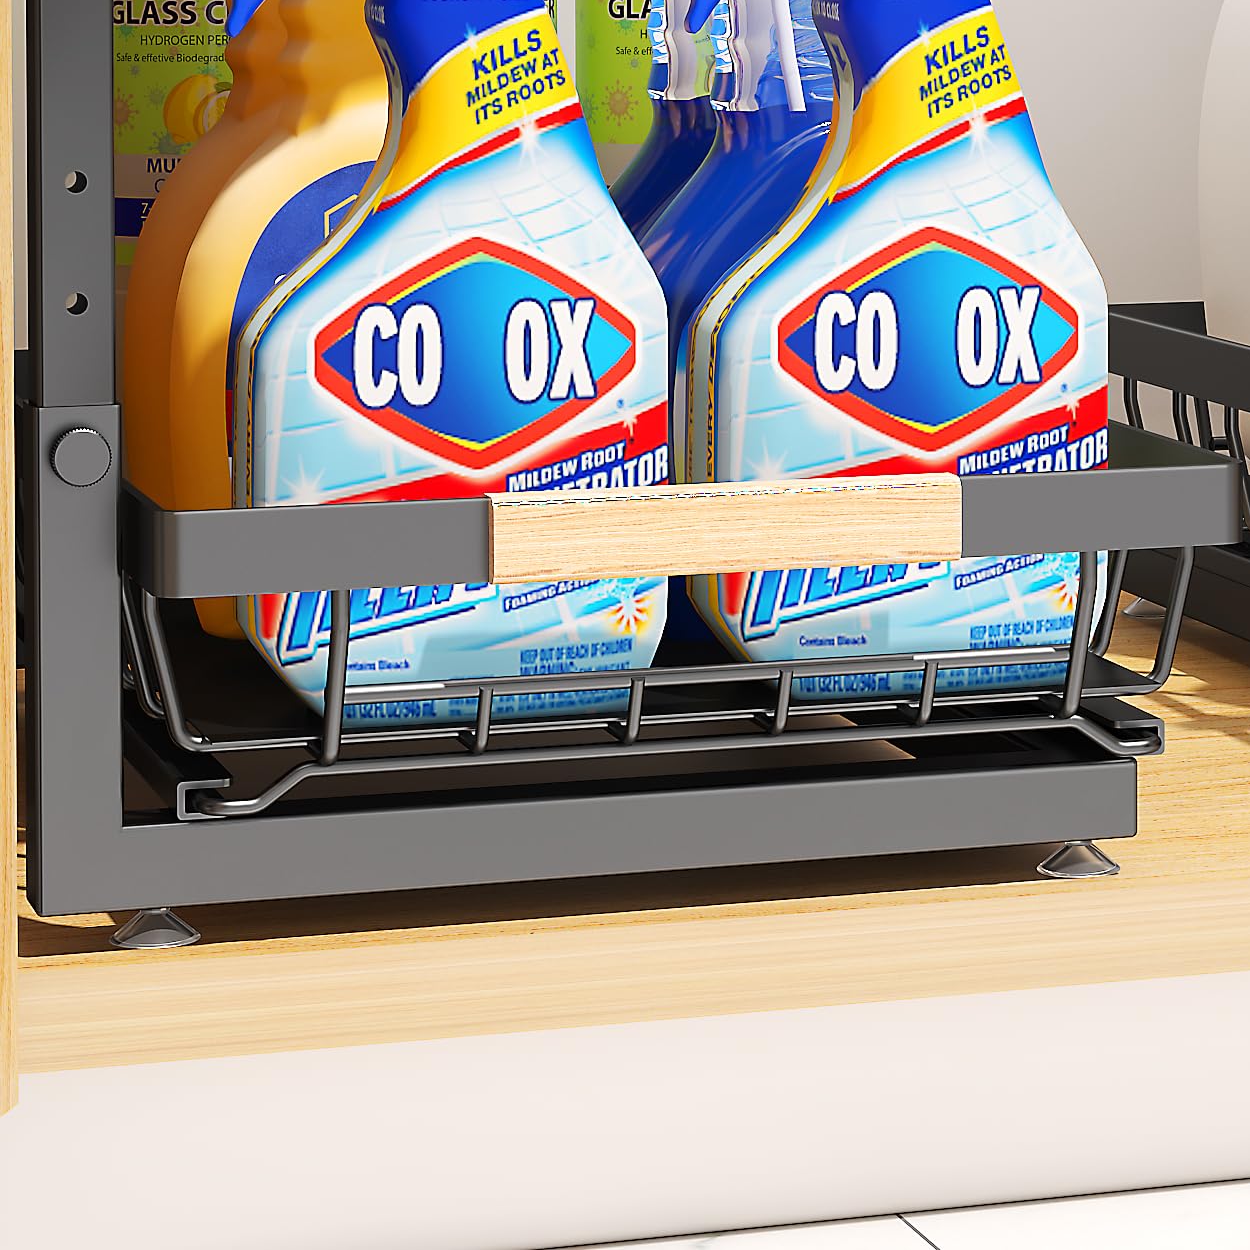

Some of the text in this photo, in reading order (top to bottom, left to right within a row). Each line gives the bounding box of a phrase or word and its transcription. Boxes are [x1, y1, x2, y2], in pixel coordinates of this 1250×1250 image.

[112, 0, 161, 25] GLASS
[116, 52, 132, 62] Safe
[133, 53, 140, 62] &
[141, 53, 175, 63] effetive
[140, 34, 205, 46] HYDROGEN
[471, 29, 541, 81] KILLS
[615, 46, 632, 56] Safe
[634, 47, 640, 56] &
[924, 25, 991, 76] KILLS
[466, 48, 559, 108] MILDEW AT
[475, 69, 566, 125] ITS ROOTS
[919, 43, 1006, 102] MILDEW AT
[927, 65, 1012, 119] ITS ROOTS
[351, 300, 444, 410] CO
[504, 297, 597, 405] OX
[814, 290, 899, 393] CO
[955, 285, 1042, 388] OX
[520, 649, 538, 665] KEEP
[541, 647, 553, 663] OUT
[566, 643, 590, 661] REACH
